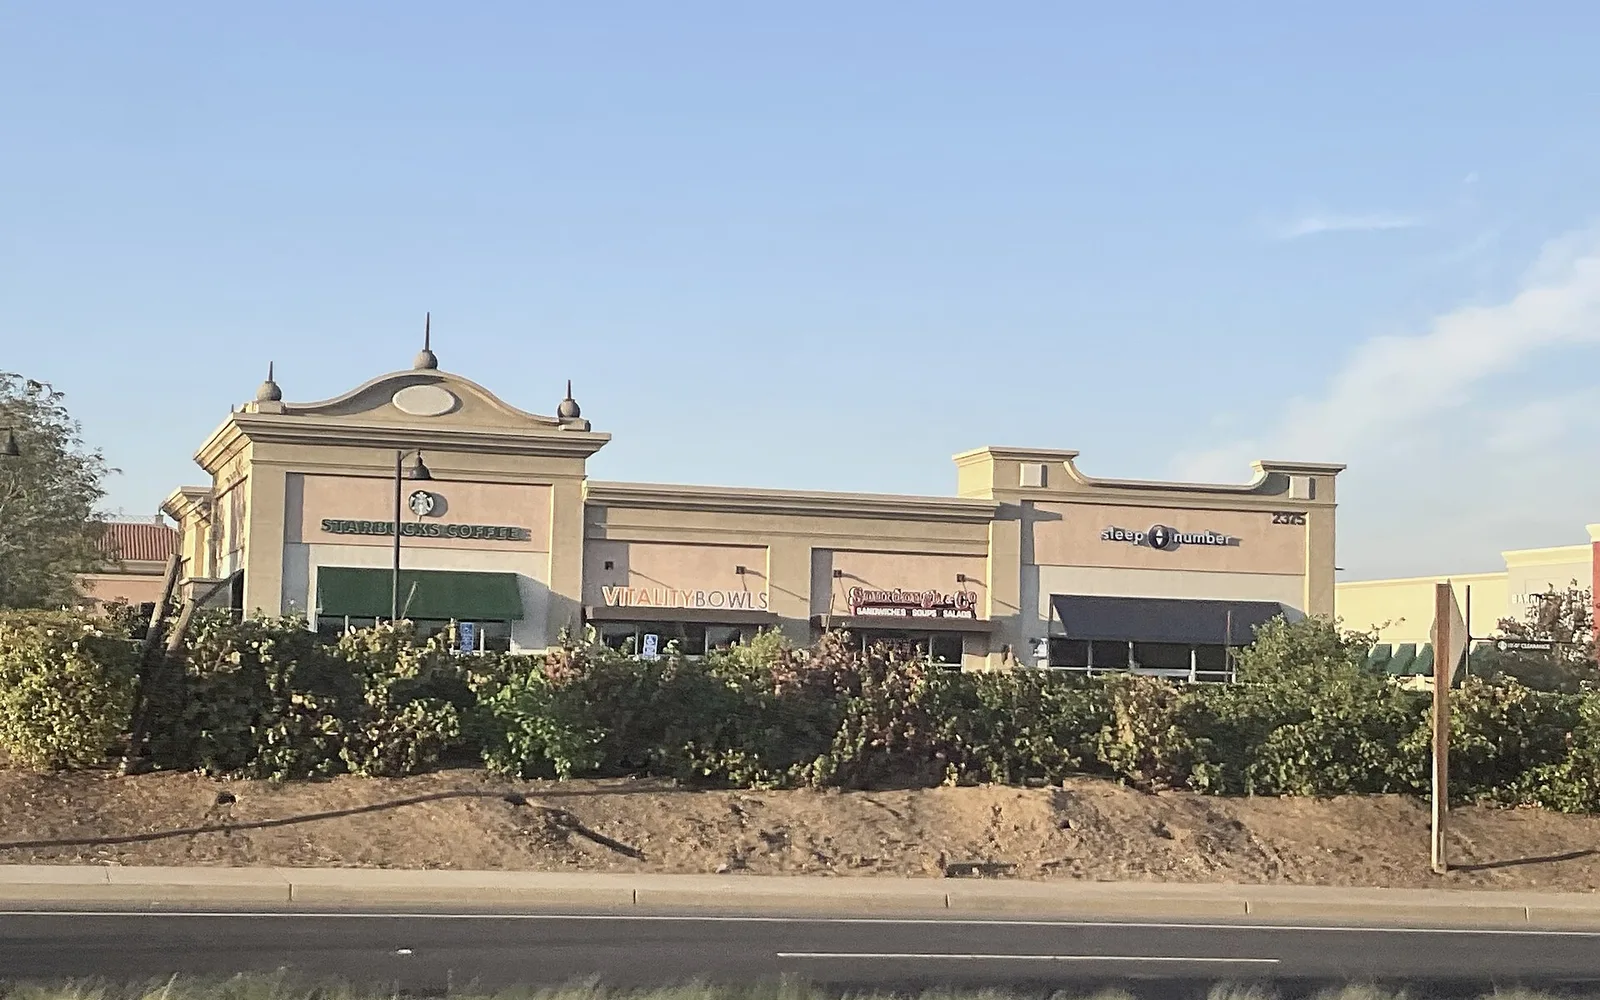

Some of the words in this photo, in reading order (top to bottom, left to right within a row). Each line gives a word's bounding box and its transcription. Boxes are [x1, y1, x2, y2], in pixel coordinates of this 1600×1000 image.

[321, 518, 441, 538] STARBUCKS
[446, 523, 522, 541] COFFEE
[1101, 526, 1143, 545] sleep
[1173, 530, 1232, 545] number
[856, 606, 906, 617] SANDWICHES
[911, 608, 937, 618] SOUPS
[942, 609, 972, 619] SALADS
